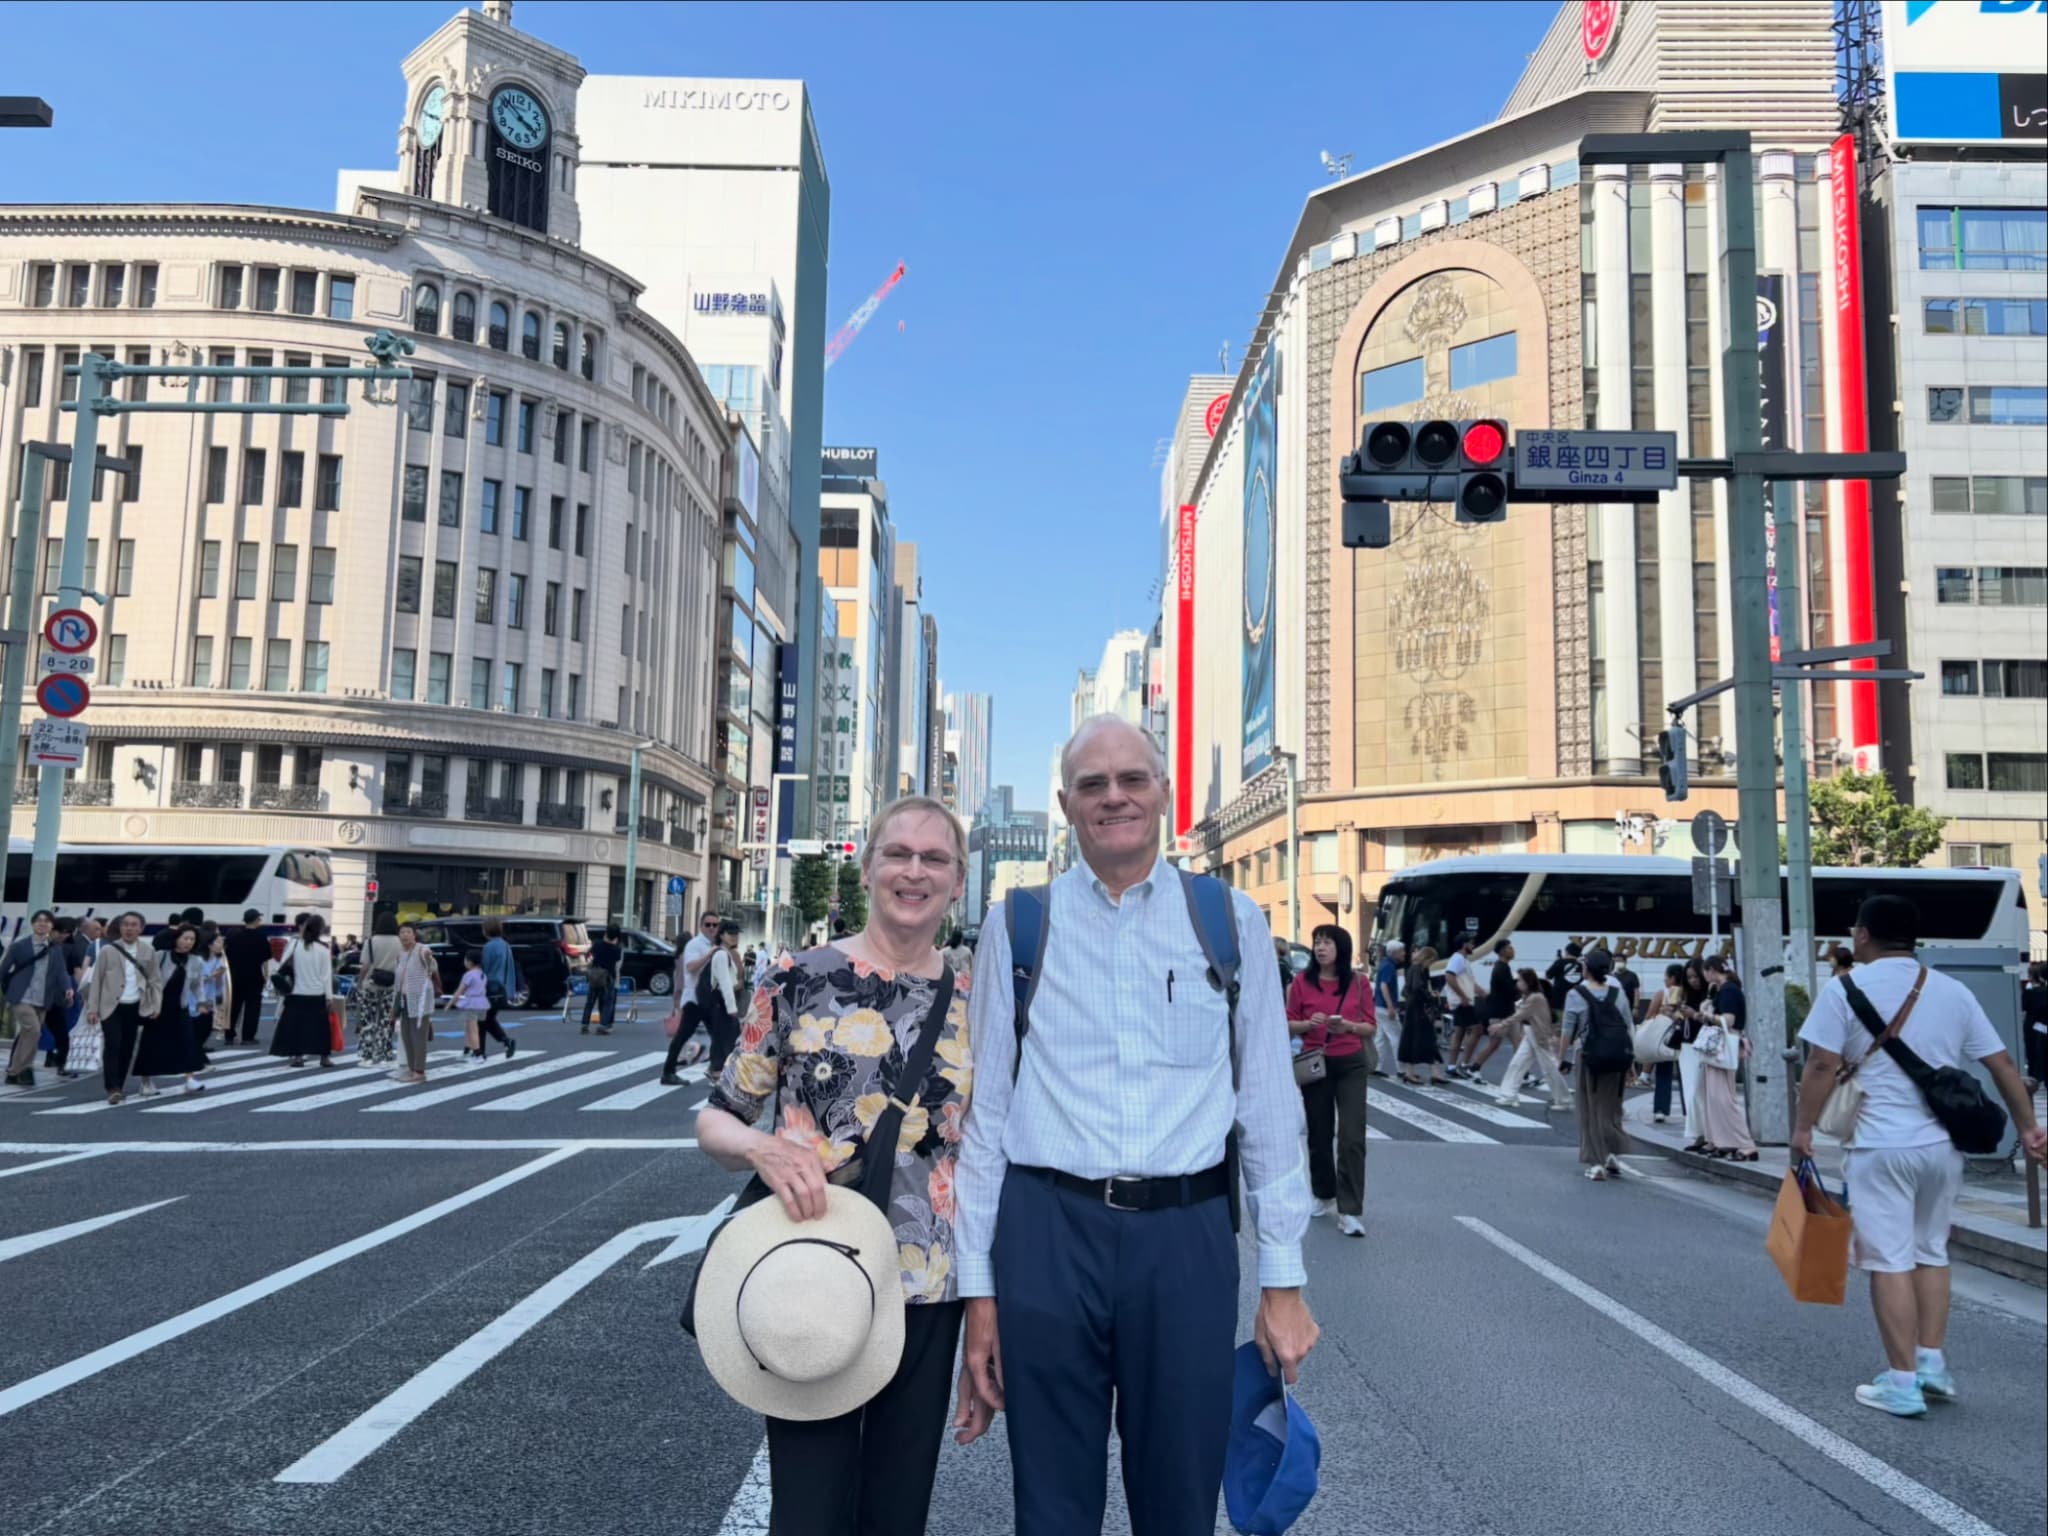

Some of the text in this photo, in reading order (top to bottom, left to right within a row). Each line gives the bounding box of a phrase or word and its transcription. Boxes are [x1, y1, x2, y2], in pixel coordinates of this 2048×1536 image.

[643, 90, 790, 111] MIKIMOTO
[496, 147, 543, 173] SEIKO
[1833, 149, 1850, 312] MITSUKOSHI
[693, 292, 766, 312] 山野楽器
[1526, 431, 1570, 443] 中央区
[821, 448, 875, 461] HUBLOT
[1526, 446, 1666, 470] 銀座四丁目
[1568, 470, 1624, 485] Ginza 4
[1181, 511, 1193, 600] MITSUKOSHI
